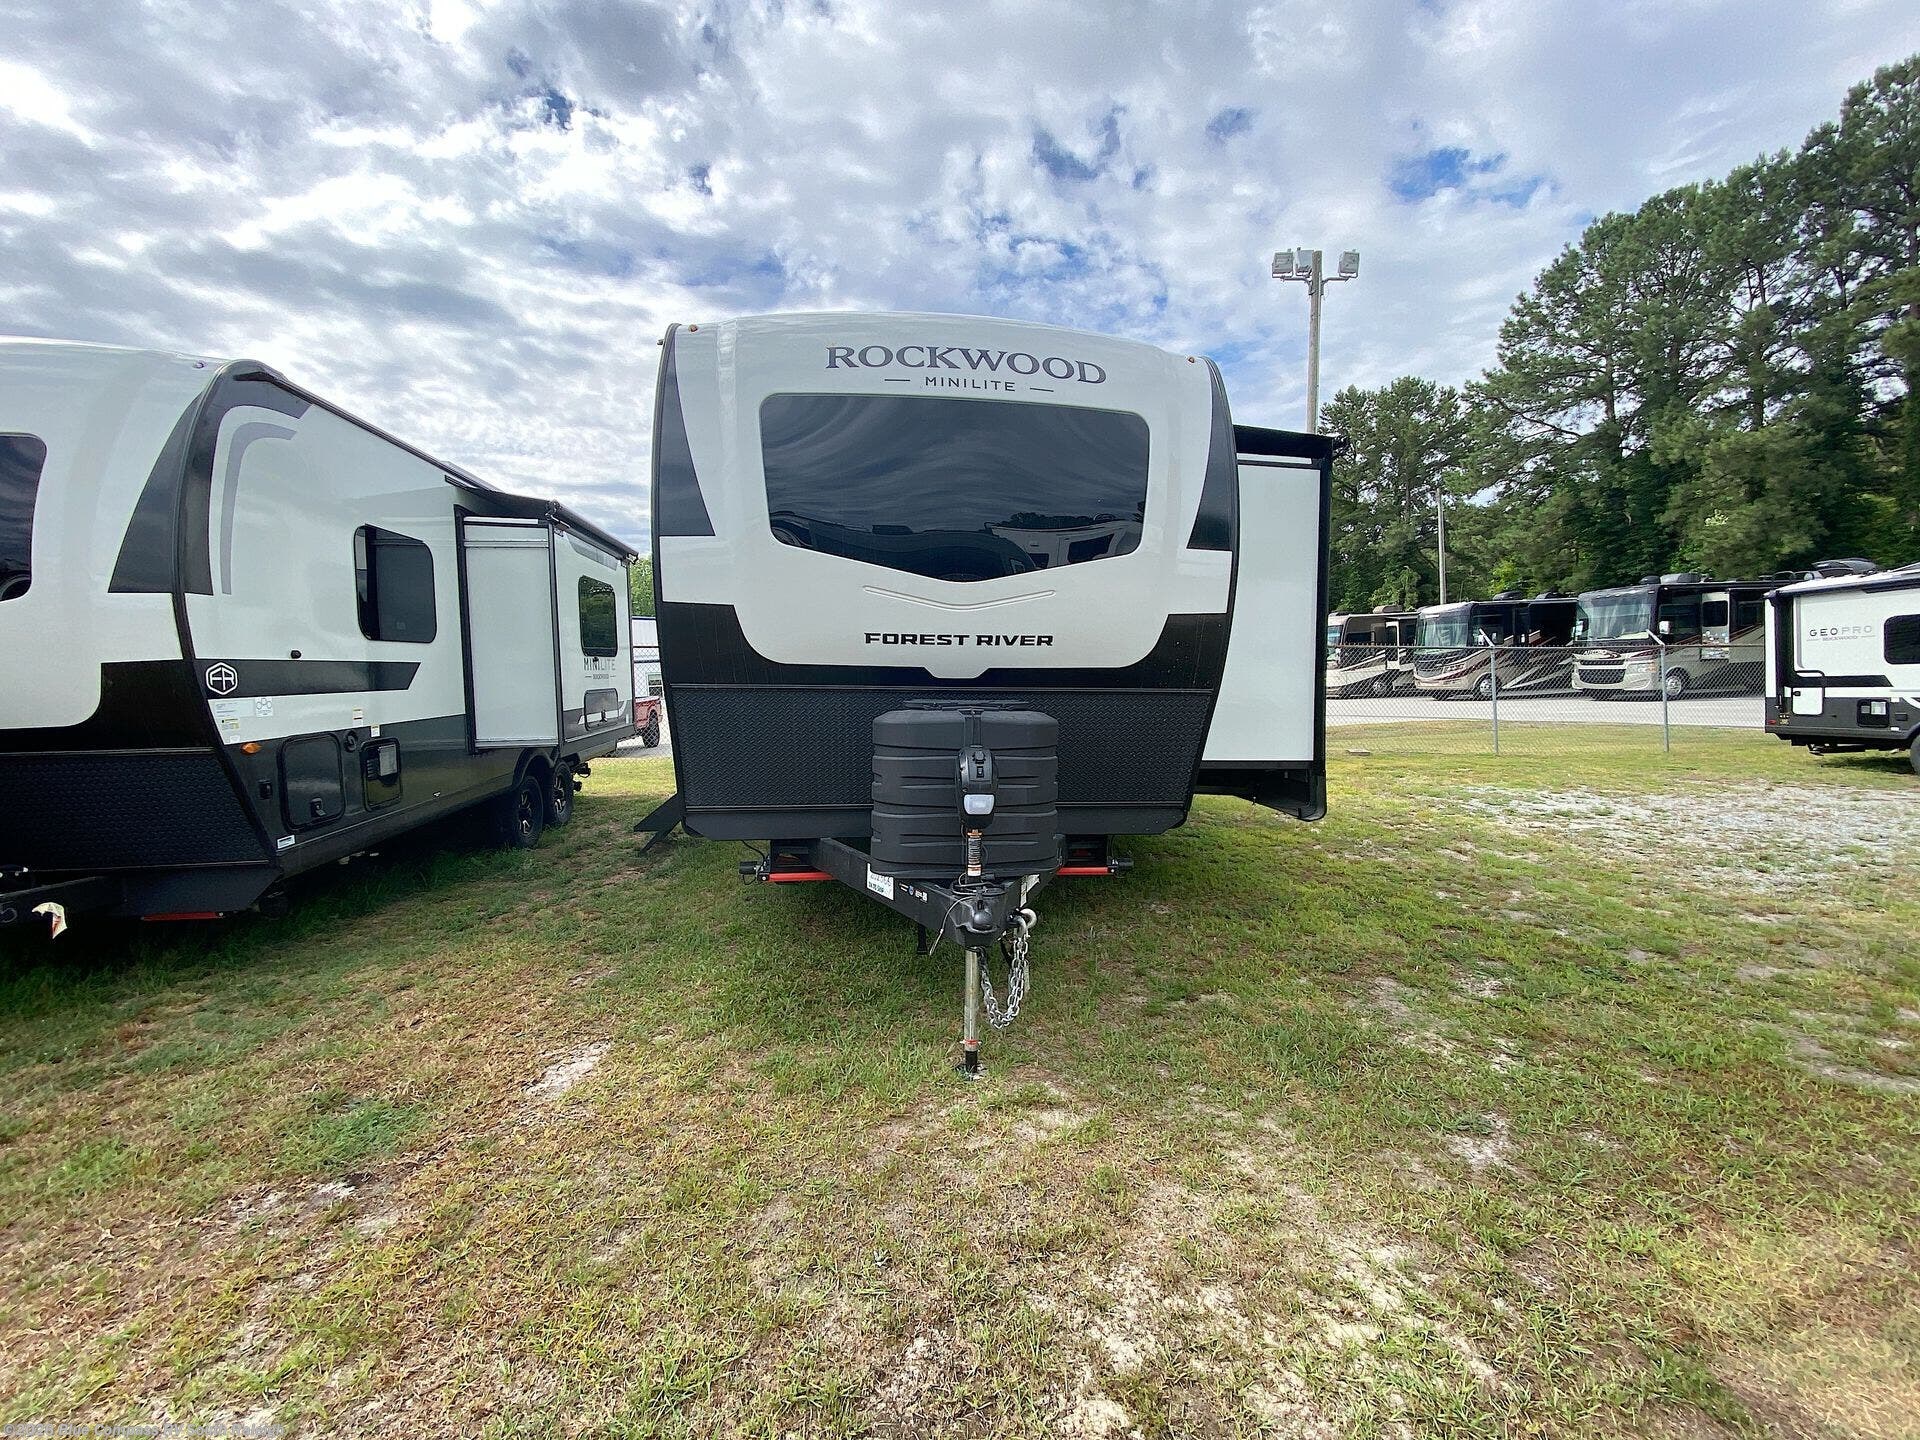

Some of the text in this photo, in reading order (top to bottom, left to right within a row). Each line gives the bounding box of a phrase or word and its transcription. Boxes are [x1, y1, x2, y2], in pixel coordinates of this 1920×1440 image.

[825, 345, 1108, 385] ROCKWOOD
[924, 375, 1016, 393] MINILITE
[864, 632, 1054, 647] FOREST RIVER
